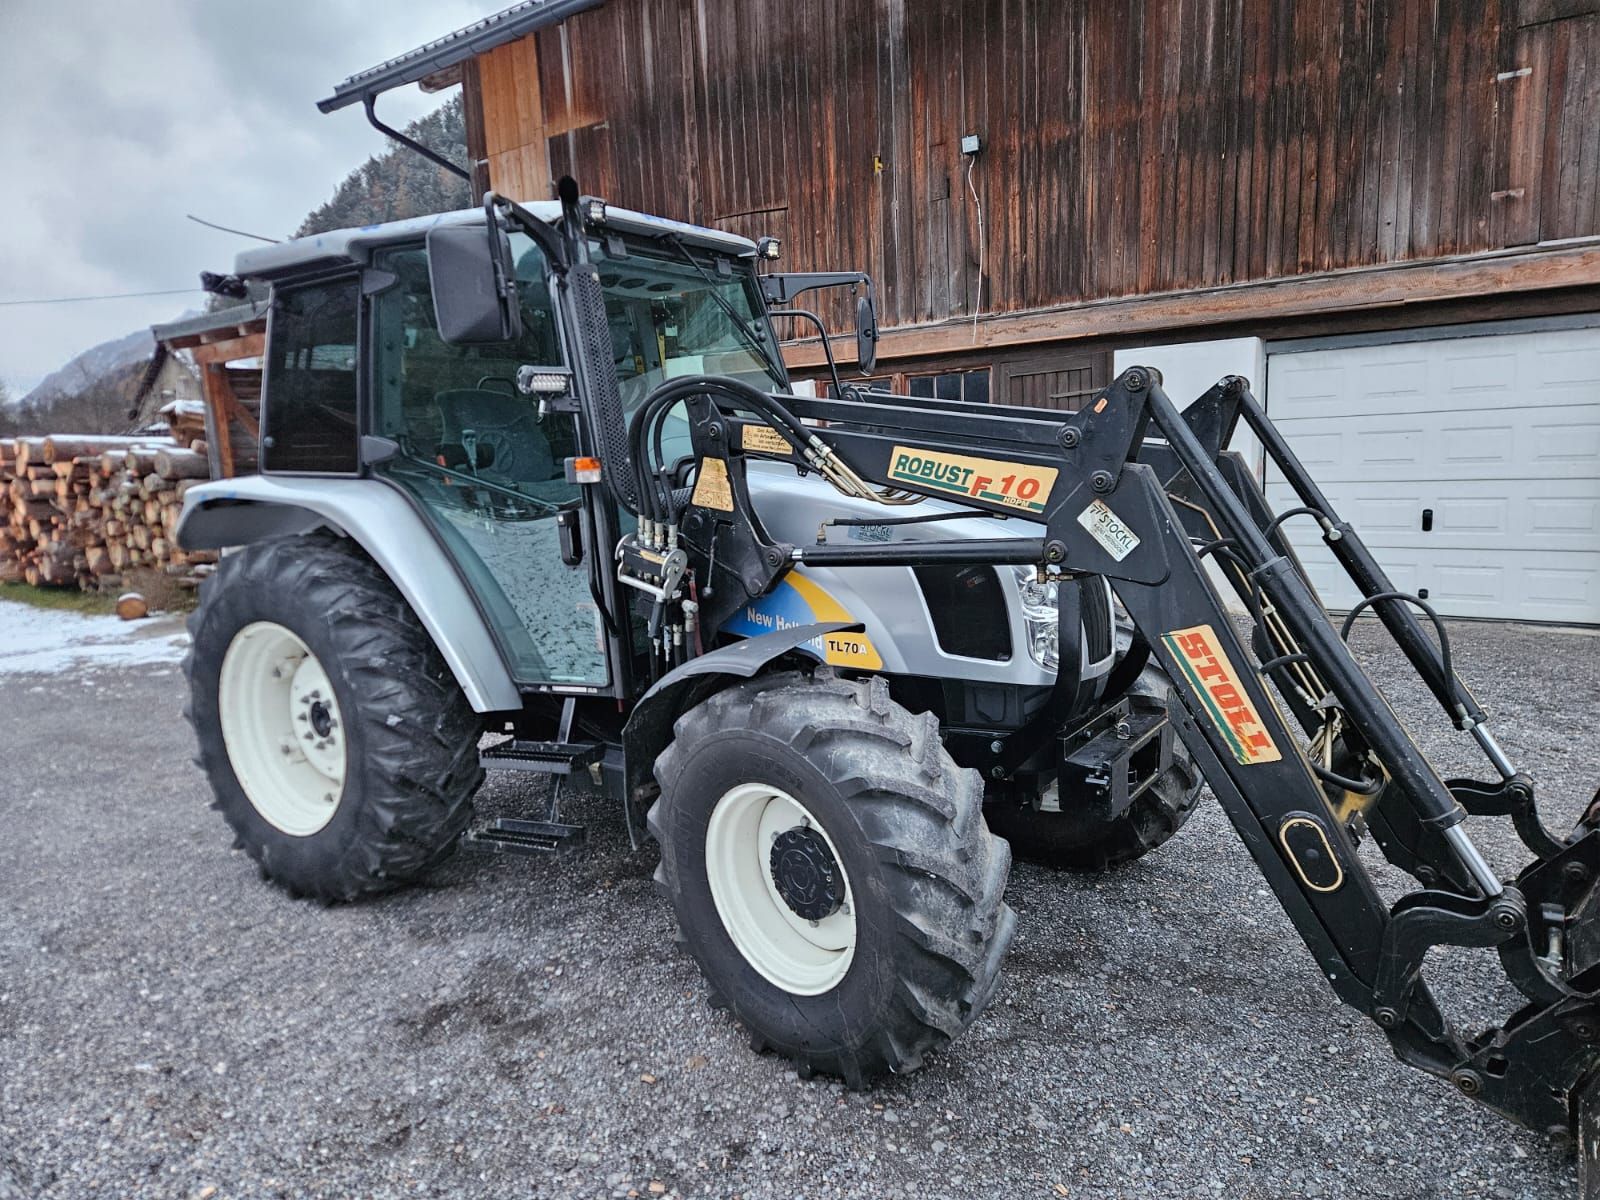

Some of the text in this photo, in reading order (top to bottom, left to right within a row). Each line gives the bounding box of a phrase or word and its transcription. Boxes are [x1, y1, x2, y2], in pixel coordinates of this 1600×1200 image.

[895, 454, 1041, 500] ROBUST F 10
[1002, 496, 1031, 508] HDPM
[747, 607, 773, 628] New
[828, 640, 868, 654] TL70A
[1177, 632, 1272, 757] STOLL
